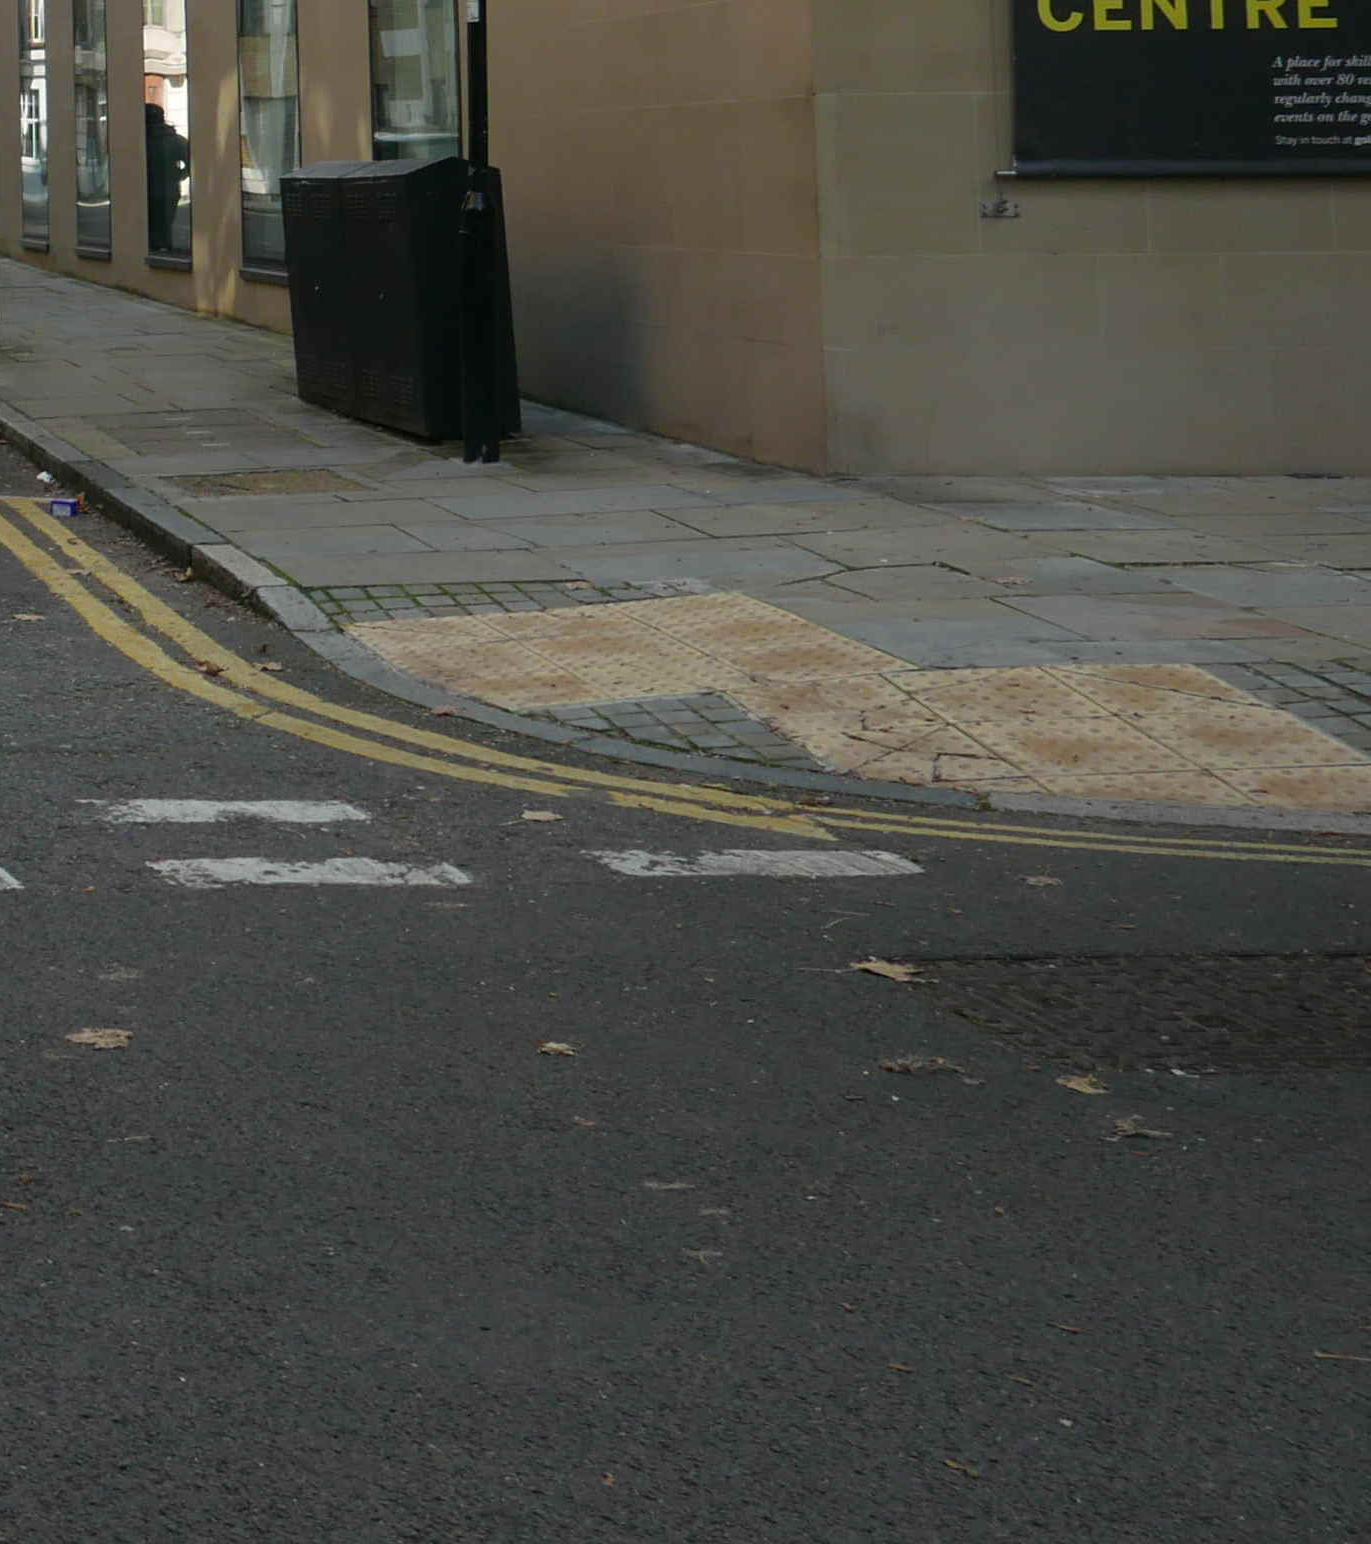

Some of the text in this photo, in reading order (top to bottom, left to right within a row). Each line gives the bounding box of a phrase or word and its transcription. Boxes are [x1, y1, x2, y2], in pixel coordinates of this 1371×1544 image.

[1271, 56, 1283, 68] A
[1285, 56, 1321, 72] place
[1320, 55, 1341, 72] for
[1273, 73, 1301, 86] with
[1305, 77, 1334, 86] over
[1274, 92, 1332, 108] regularly
[1274, 112, 1313, 123] events
[1338, 111, 1358, 121] the
